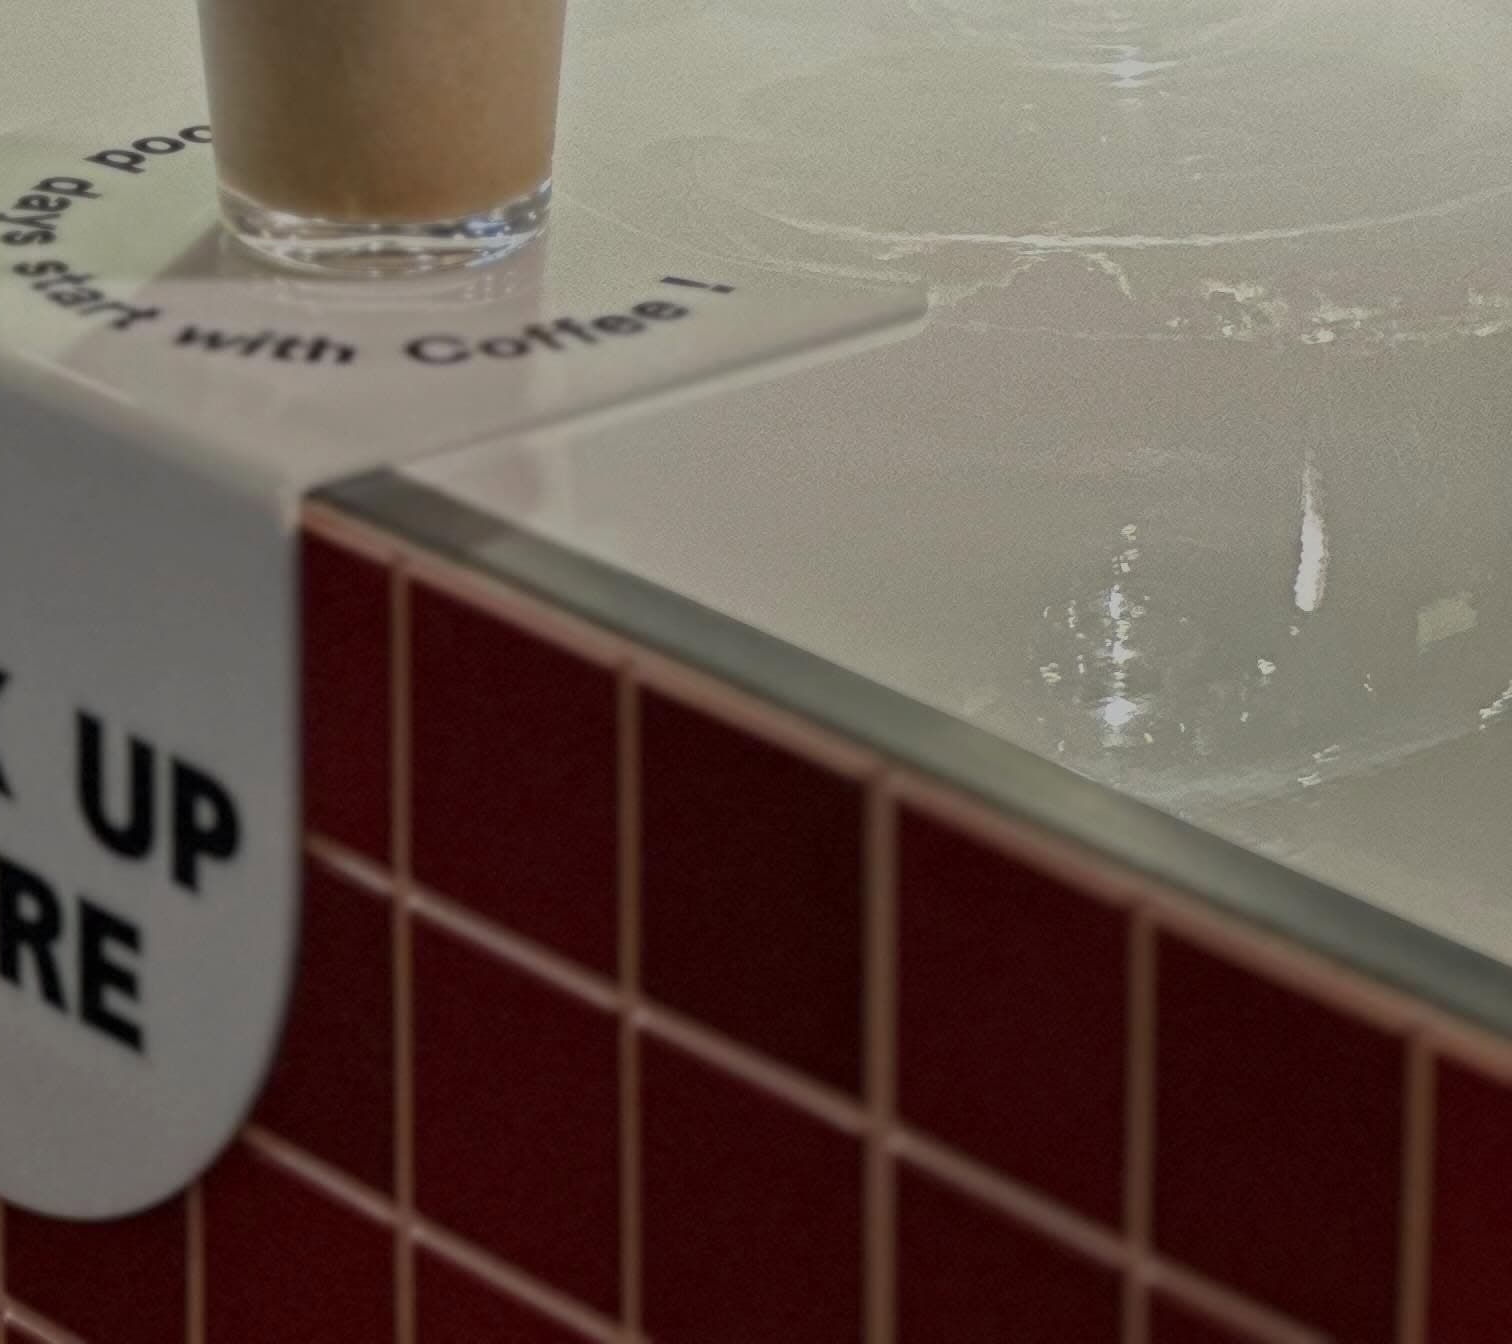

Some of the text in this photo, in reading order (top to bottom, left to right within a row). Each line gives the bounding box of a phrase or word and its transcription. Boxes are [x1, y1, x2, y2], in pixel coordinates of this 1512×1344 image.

[82, 123, 213, 175] ood
[10, 257, 161, 332] start
[172, 324, 359, 367] with
[73, 707, 245, 896] UP
